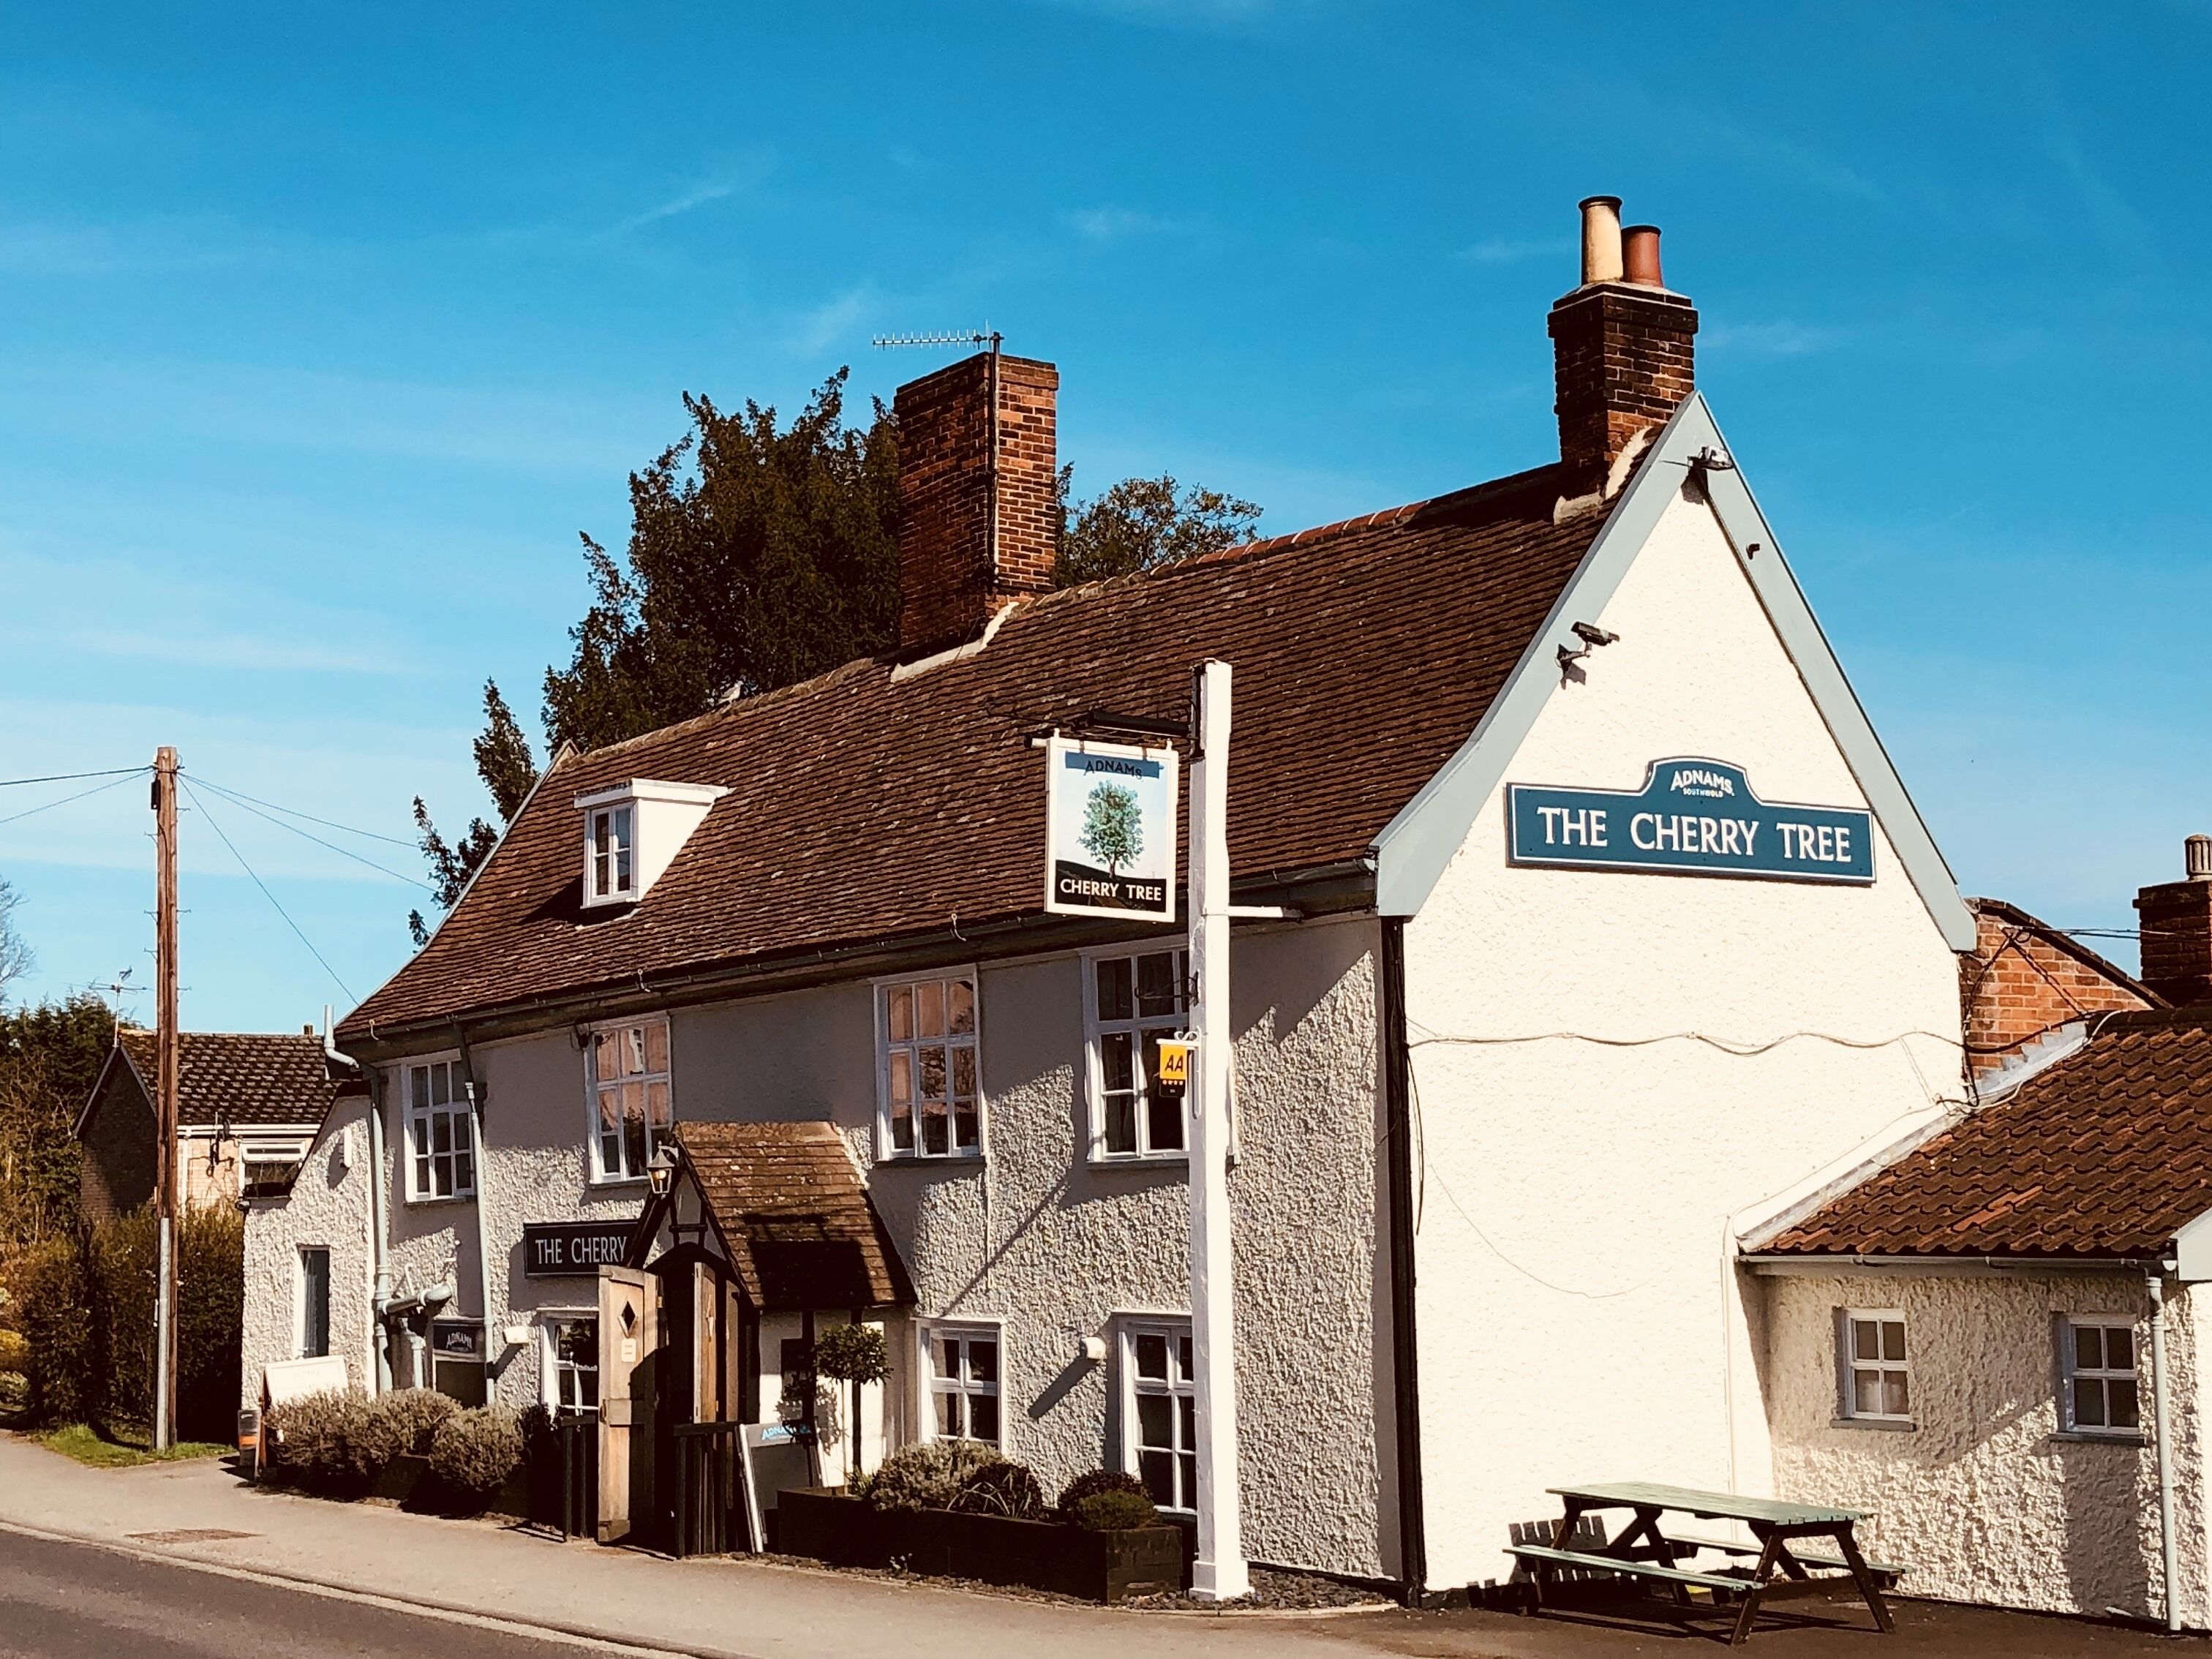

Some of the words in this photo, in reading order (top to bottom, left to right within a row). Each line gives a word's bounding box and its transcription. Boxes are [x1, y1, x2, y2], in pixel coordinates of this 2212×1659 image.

[1537, 807, 1608, 847] THE
[1630, 813, 1759, 856] CHERRY
[1776, 823, 1851, 862] TREE
[1061, 879, 1119, 897] CHERRY
[1126, 884, 1162, 901] TREE
[1165, 1054, 1184, 1072] AA
[535, 1238, 563, 1265] THE
[571, 1236, 627, 1263] CHERRY
